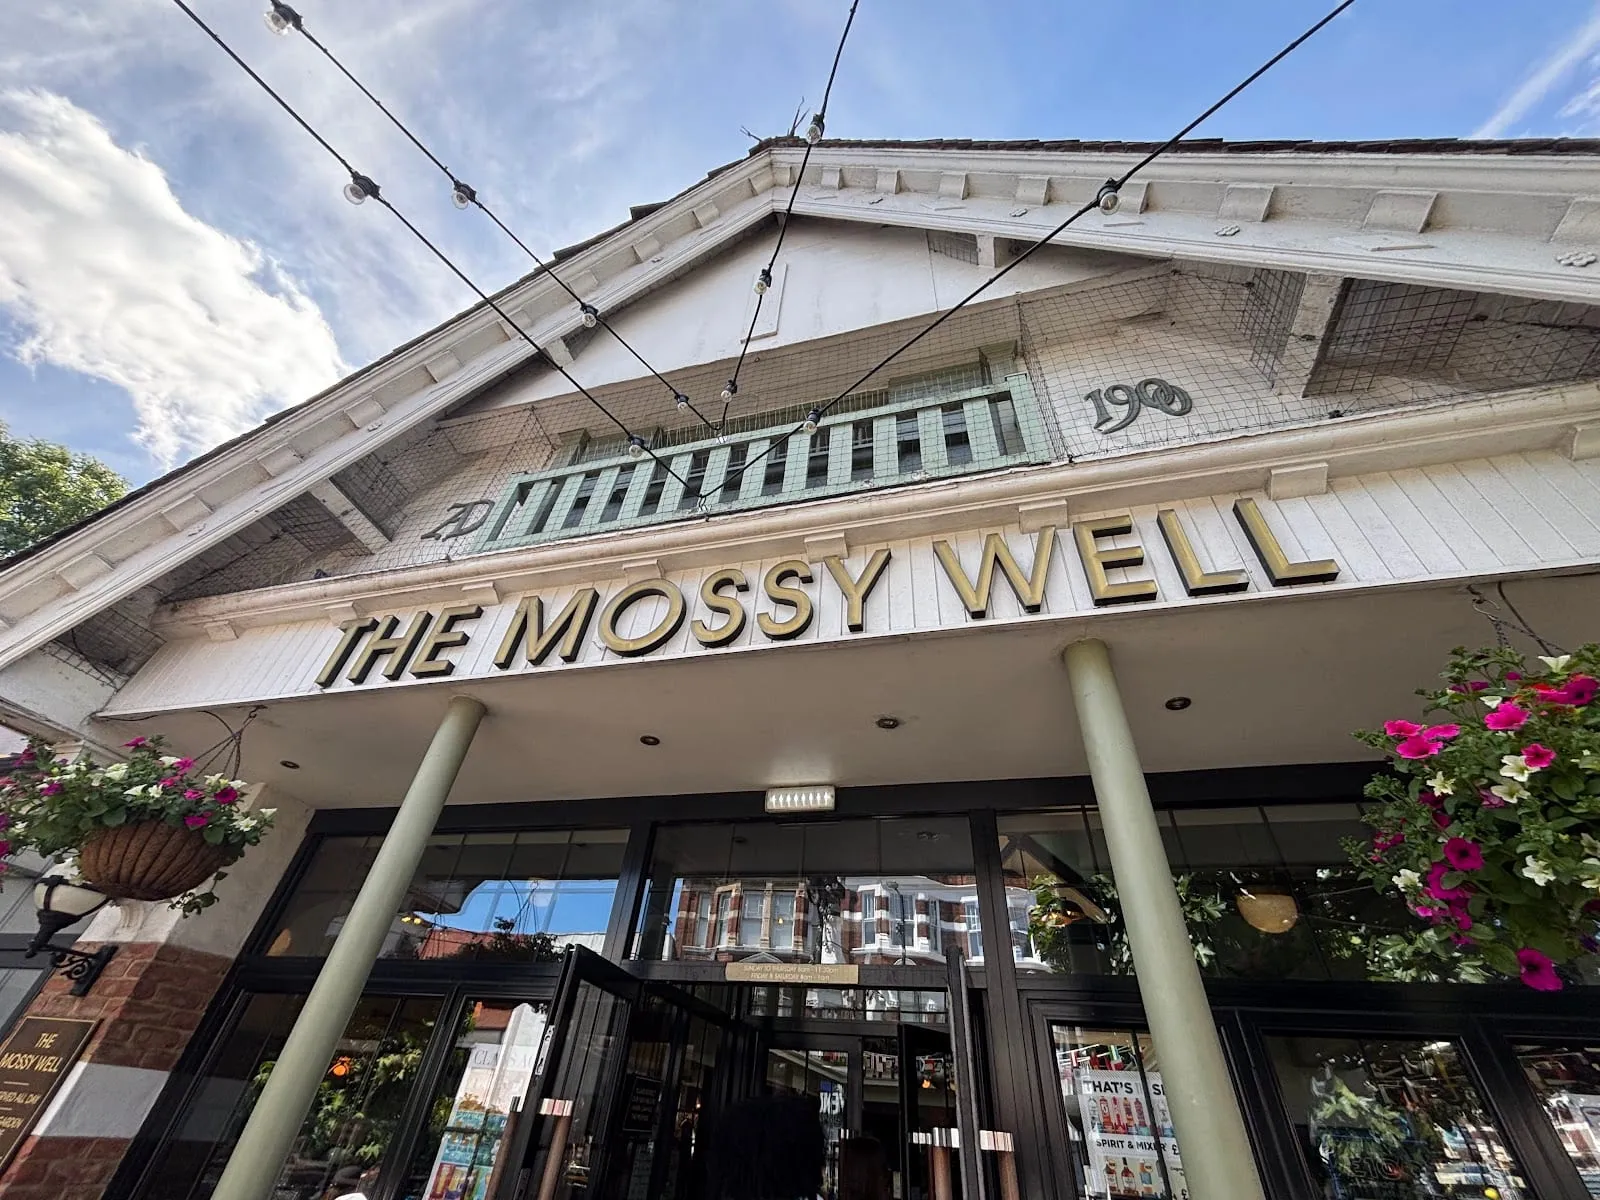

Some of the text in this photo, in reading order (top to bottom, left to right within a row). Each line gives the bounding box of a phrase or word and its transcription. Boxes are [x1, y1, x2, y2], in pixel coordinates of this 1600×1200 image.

[1084, 377, 1192, 435] 1900
[420, 499, 496, 542] AD
[314, 498, 1341, 690] THE MOSSY WELL
[34, 1032, 59, 1049] THE
[0, 1053, 63, 1073] MOSSY WELL
[1083, 1080, 1134, 1094] THAT'S
[24, 1094, 42, 1105] DAY
[1096, 1139, 1125, 1149] SPIRIT
[1127, 1140, 1134, 1149] &
